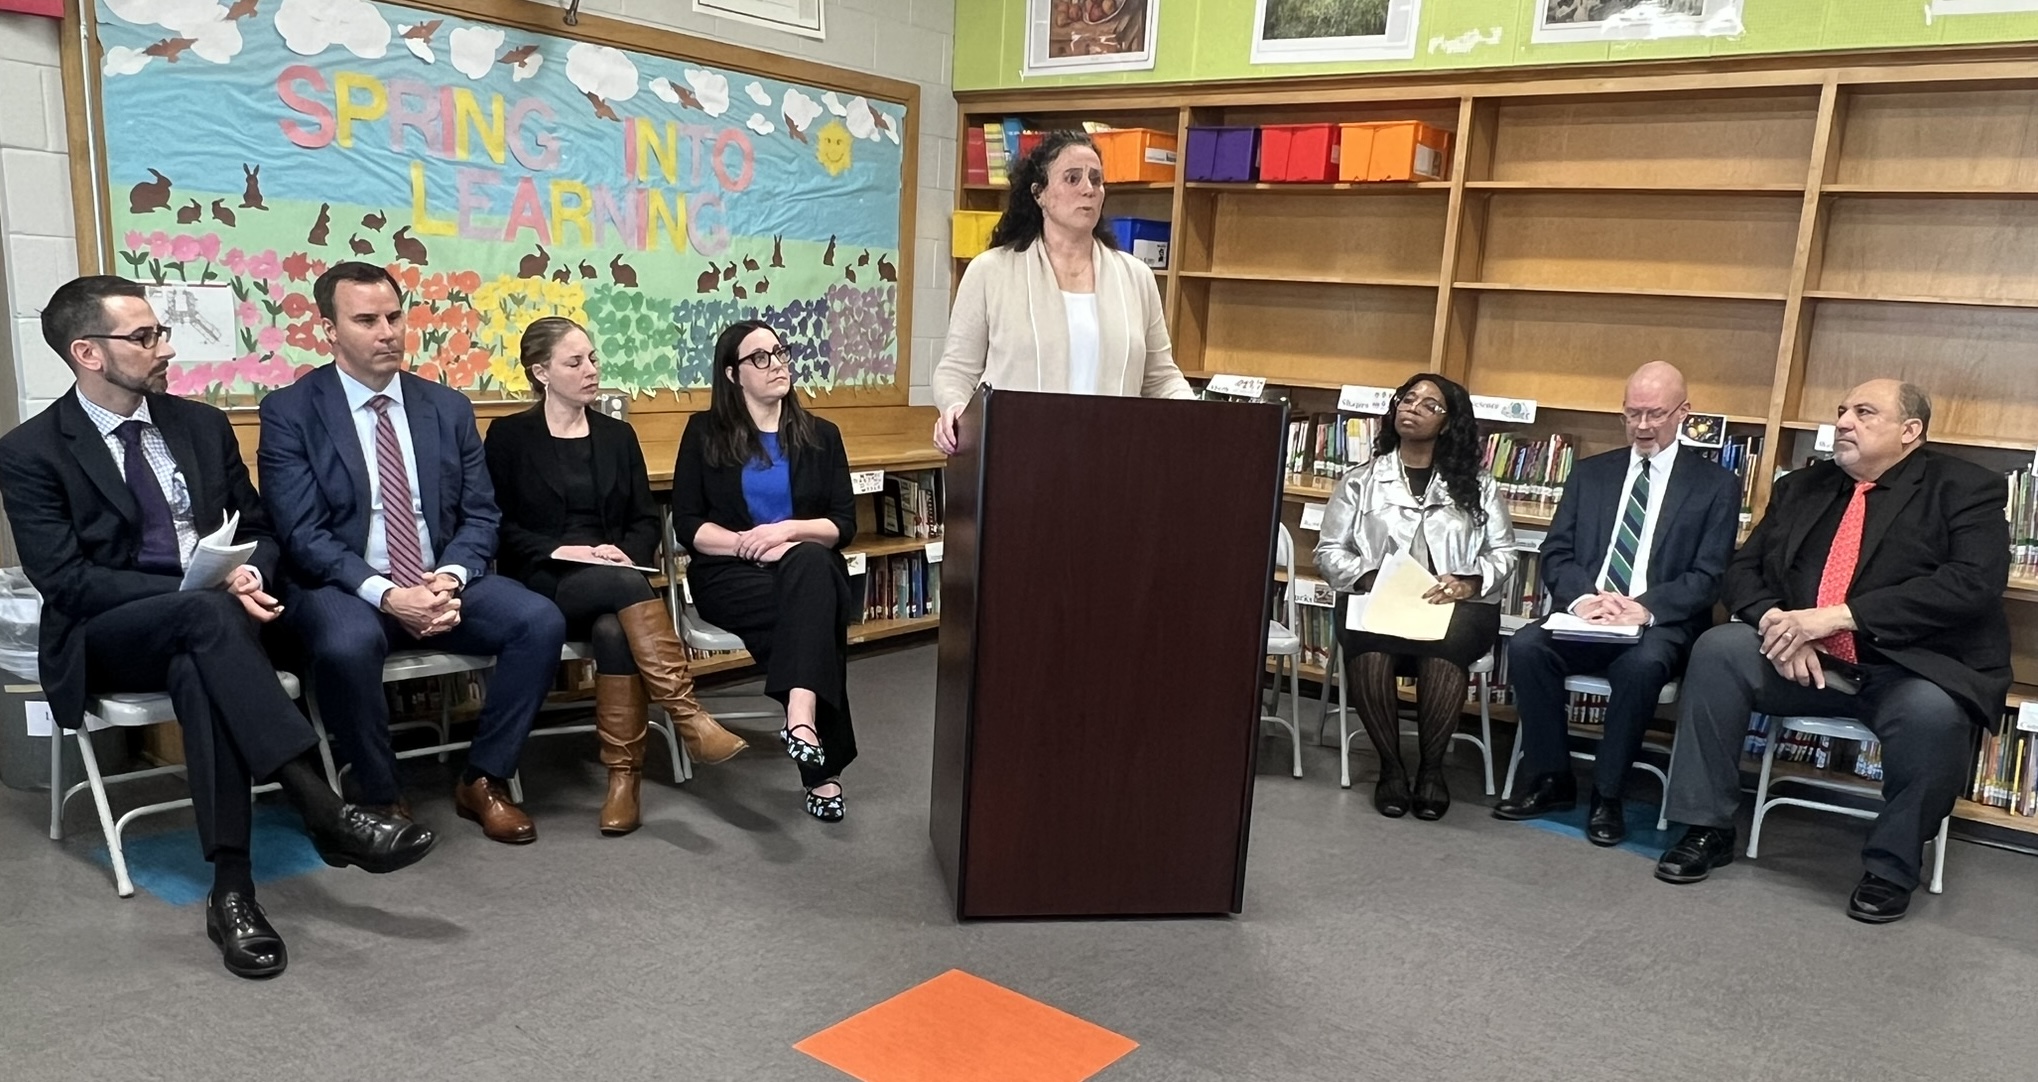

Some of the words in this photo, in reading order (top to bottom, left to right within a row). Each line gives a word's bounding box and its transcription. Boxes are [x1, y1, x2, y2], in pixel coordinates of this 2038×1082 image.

[277, 65, 561, 171] SPRING
[624, 116, 756, 192] INTO
[410, 160, 732, 257] LEARNING
